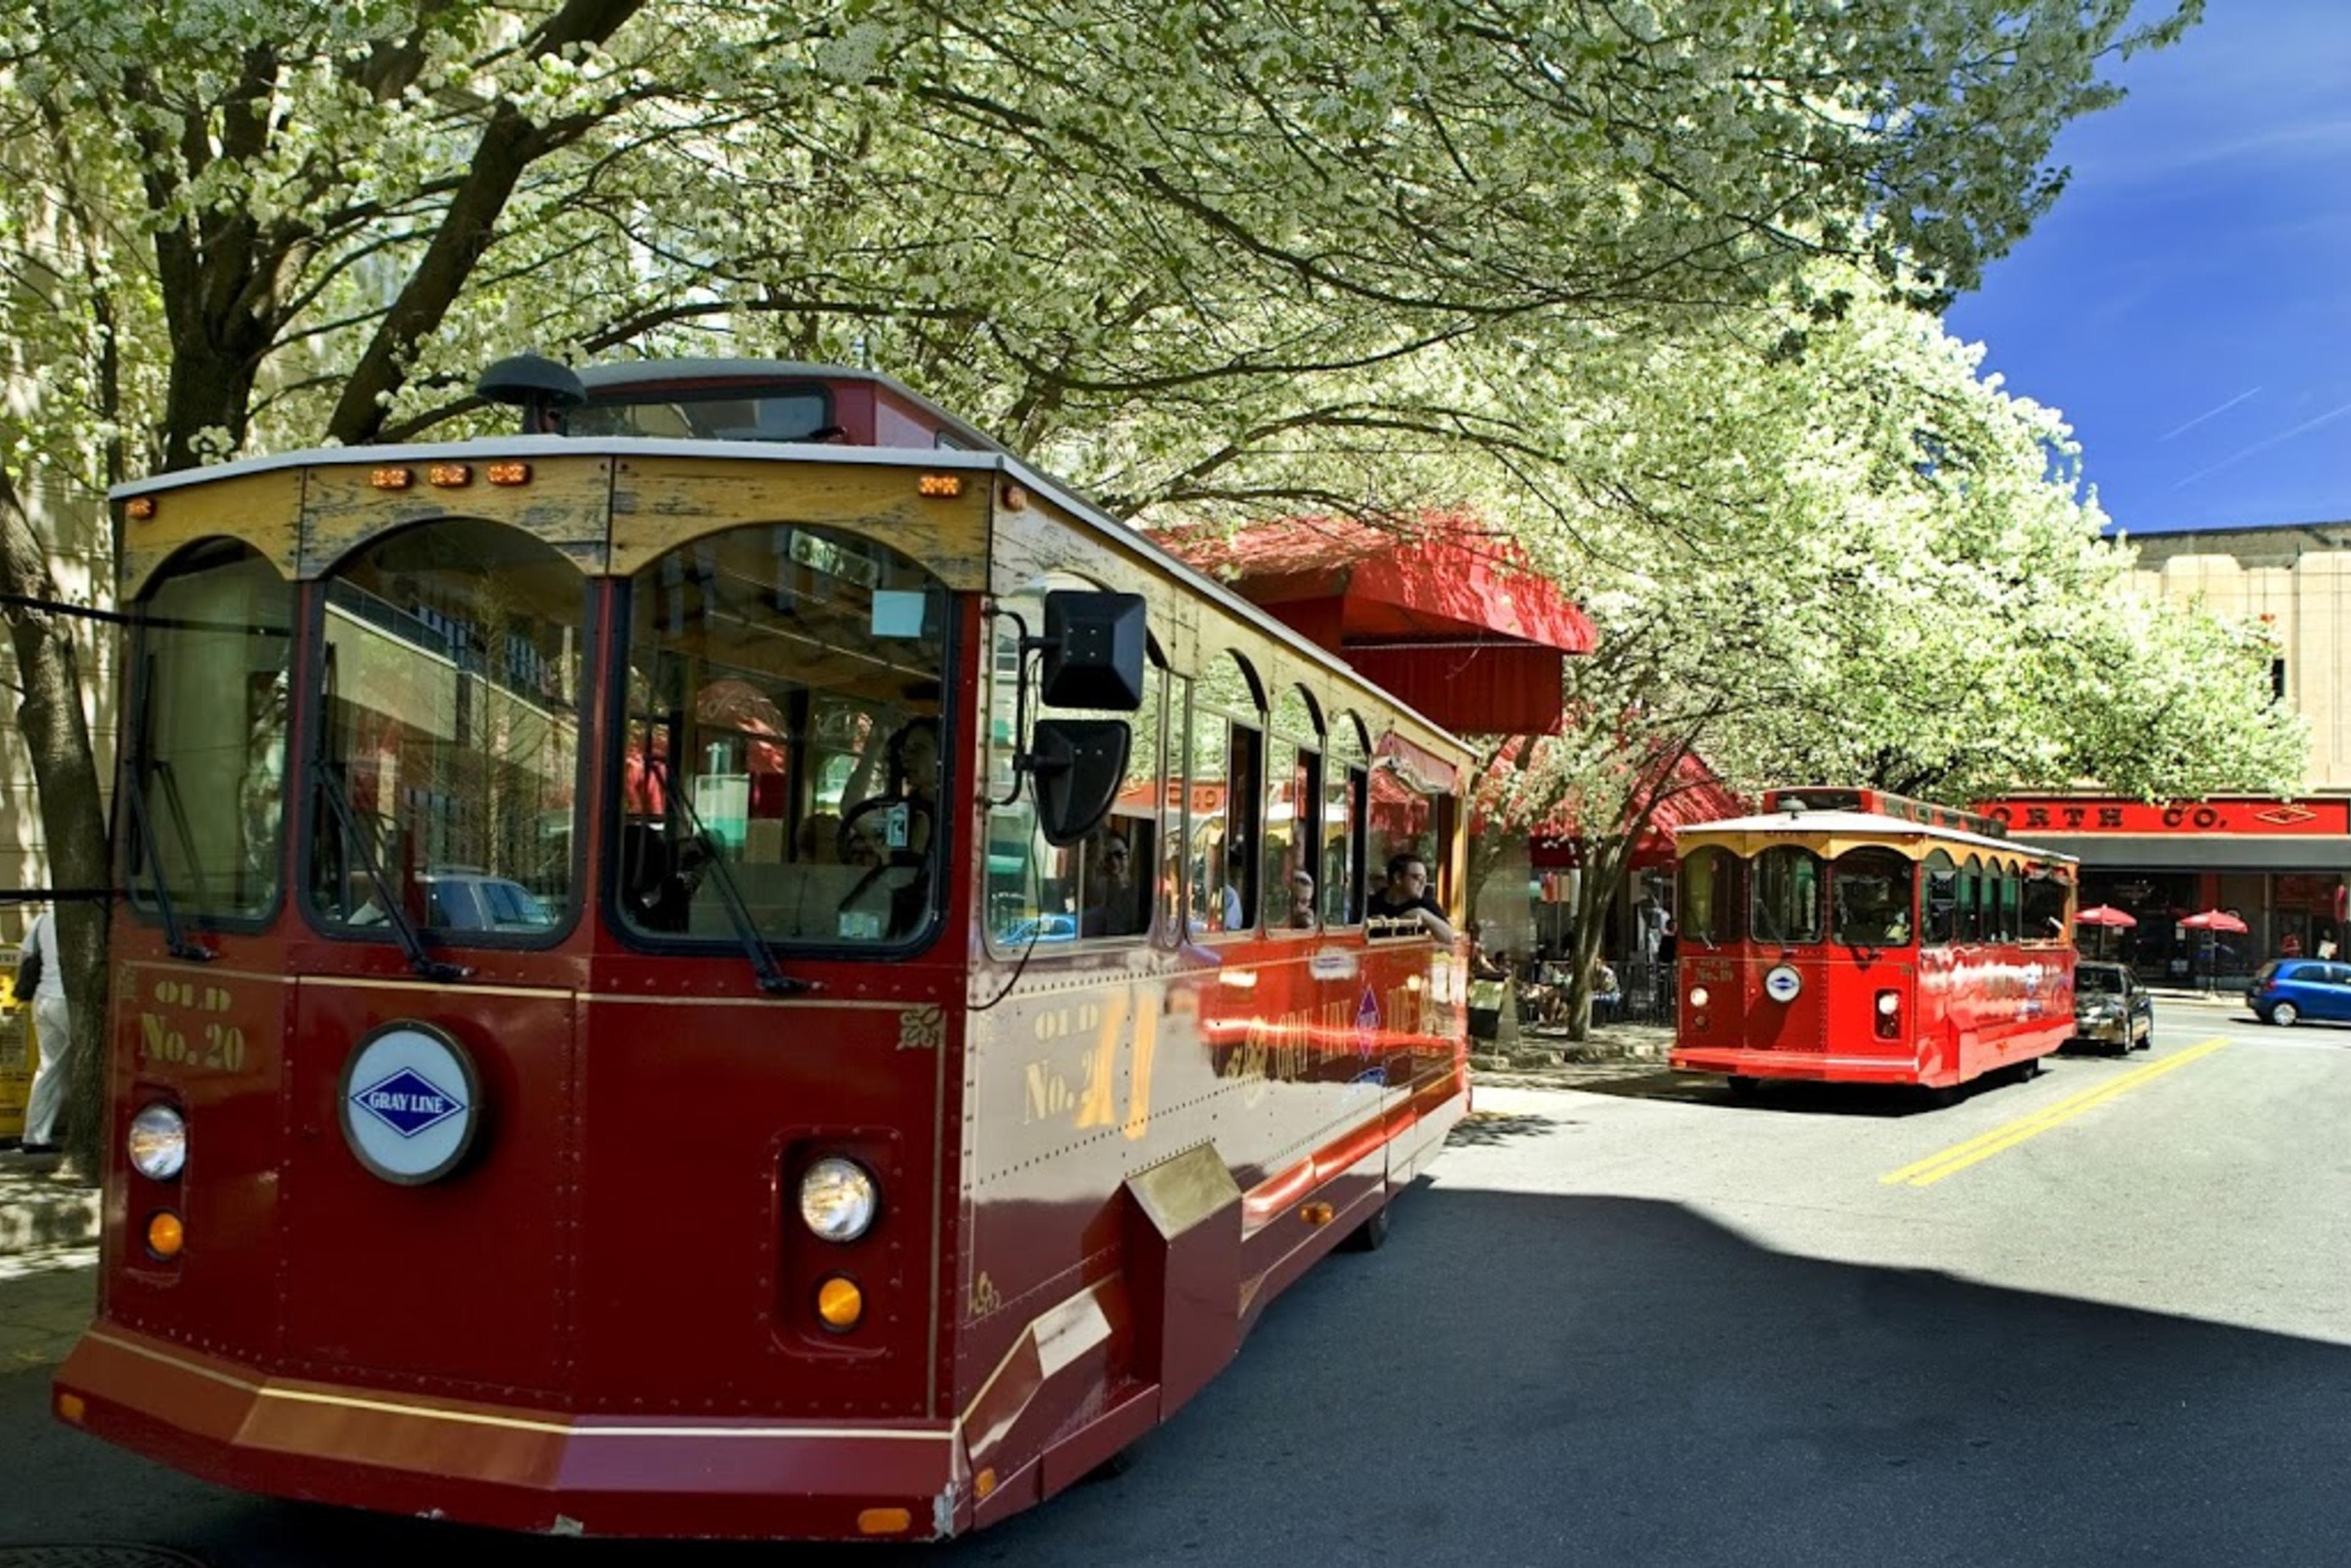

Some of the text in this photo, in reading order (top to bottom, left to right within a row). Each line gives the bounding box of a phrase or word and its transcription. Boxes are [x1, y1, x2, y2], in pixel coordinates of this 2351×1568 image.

[2162, 808, 2227, 828] CO.
[154, 981, 232, 1012] OLD
[1035, 1002, 1099, 1041] OLD
[138, 1012, 244, 1072] No. 20
[369, 1091, 443, 1114] GRAY LINE
[1024, 1059, 1075, 1125] No.
